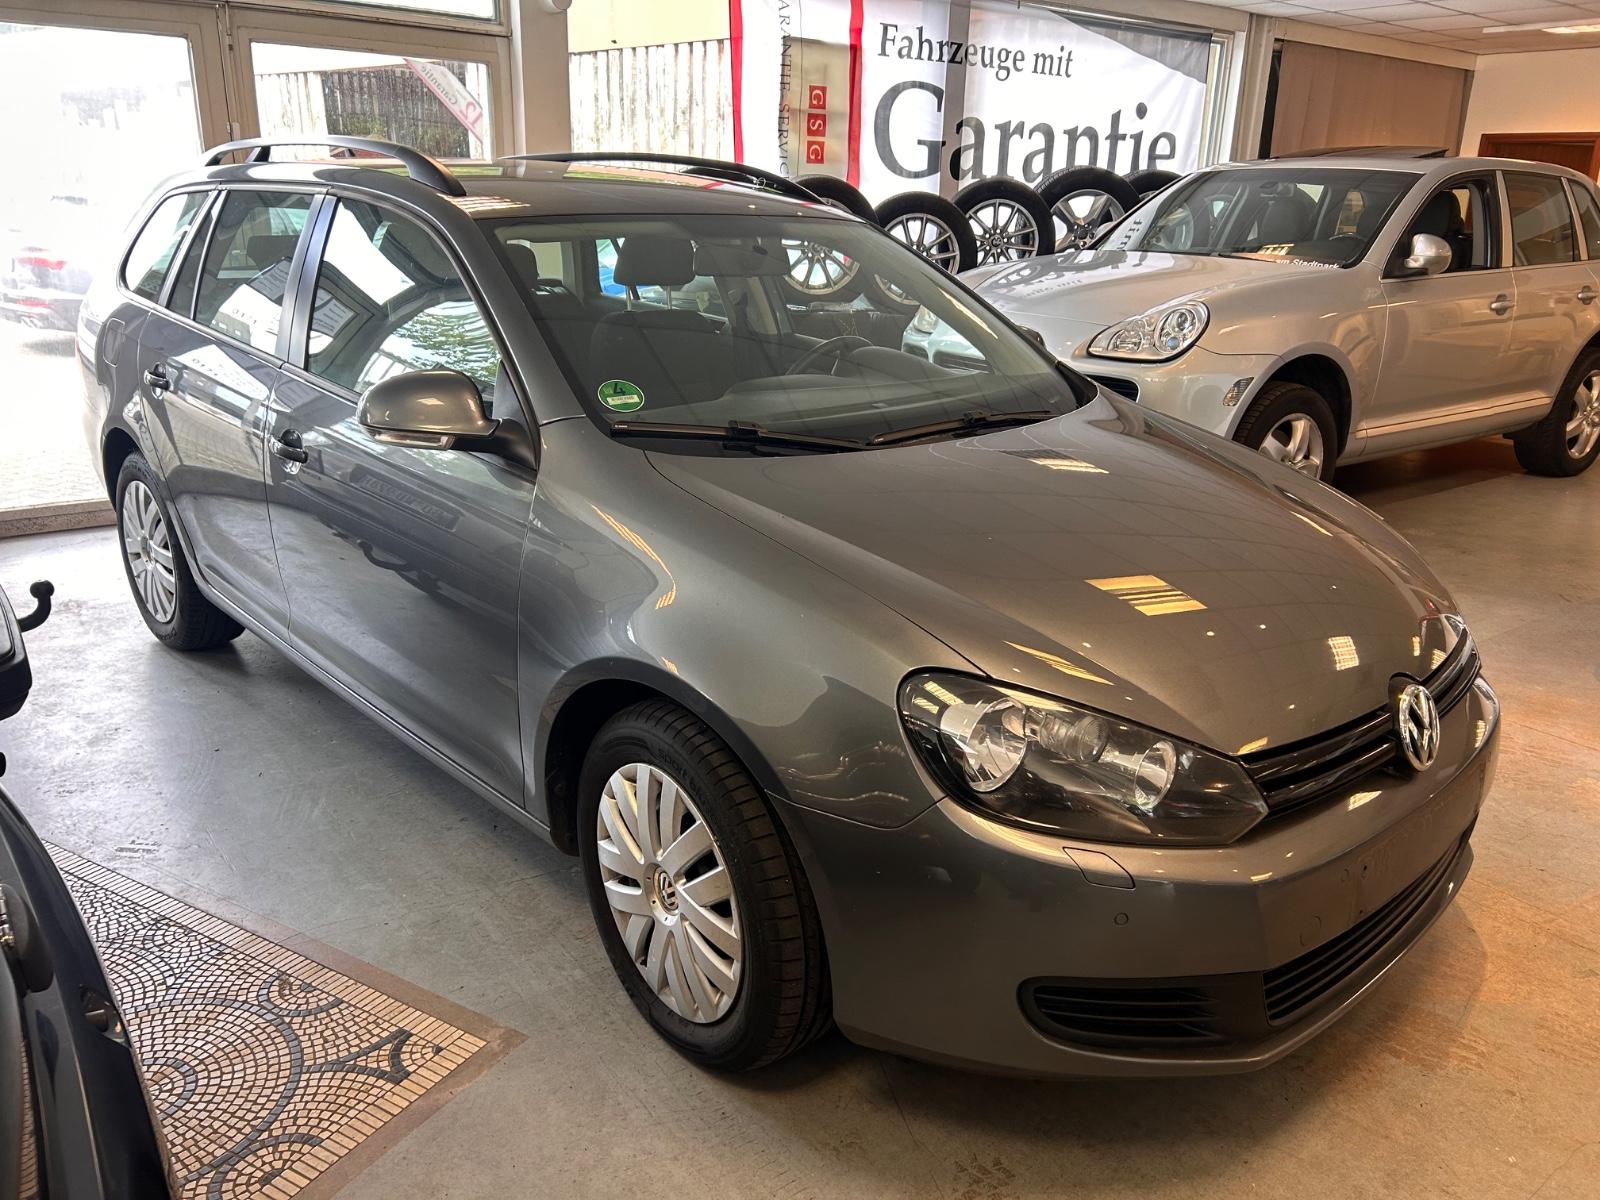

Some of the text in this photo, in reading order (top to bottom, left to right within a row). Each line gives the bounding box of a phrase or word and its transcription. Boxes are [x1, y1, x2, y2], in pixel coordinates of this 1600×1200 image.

[877, 22, 1074, 82] Fahrzeuge mit
[873, 80, 1177, 186] Garantie
[613, 382, 626, 397] 4
